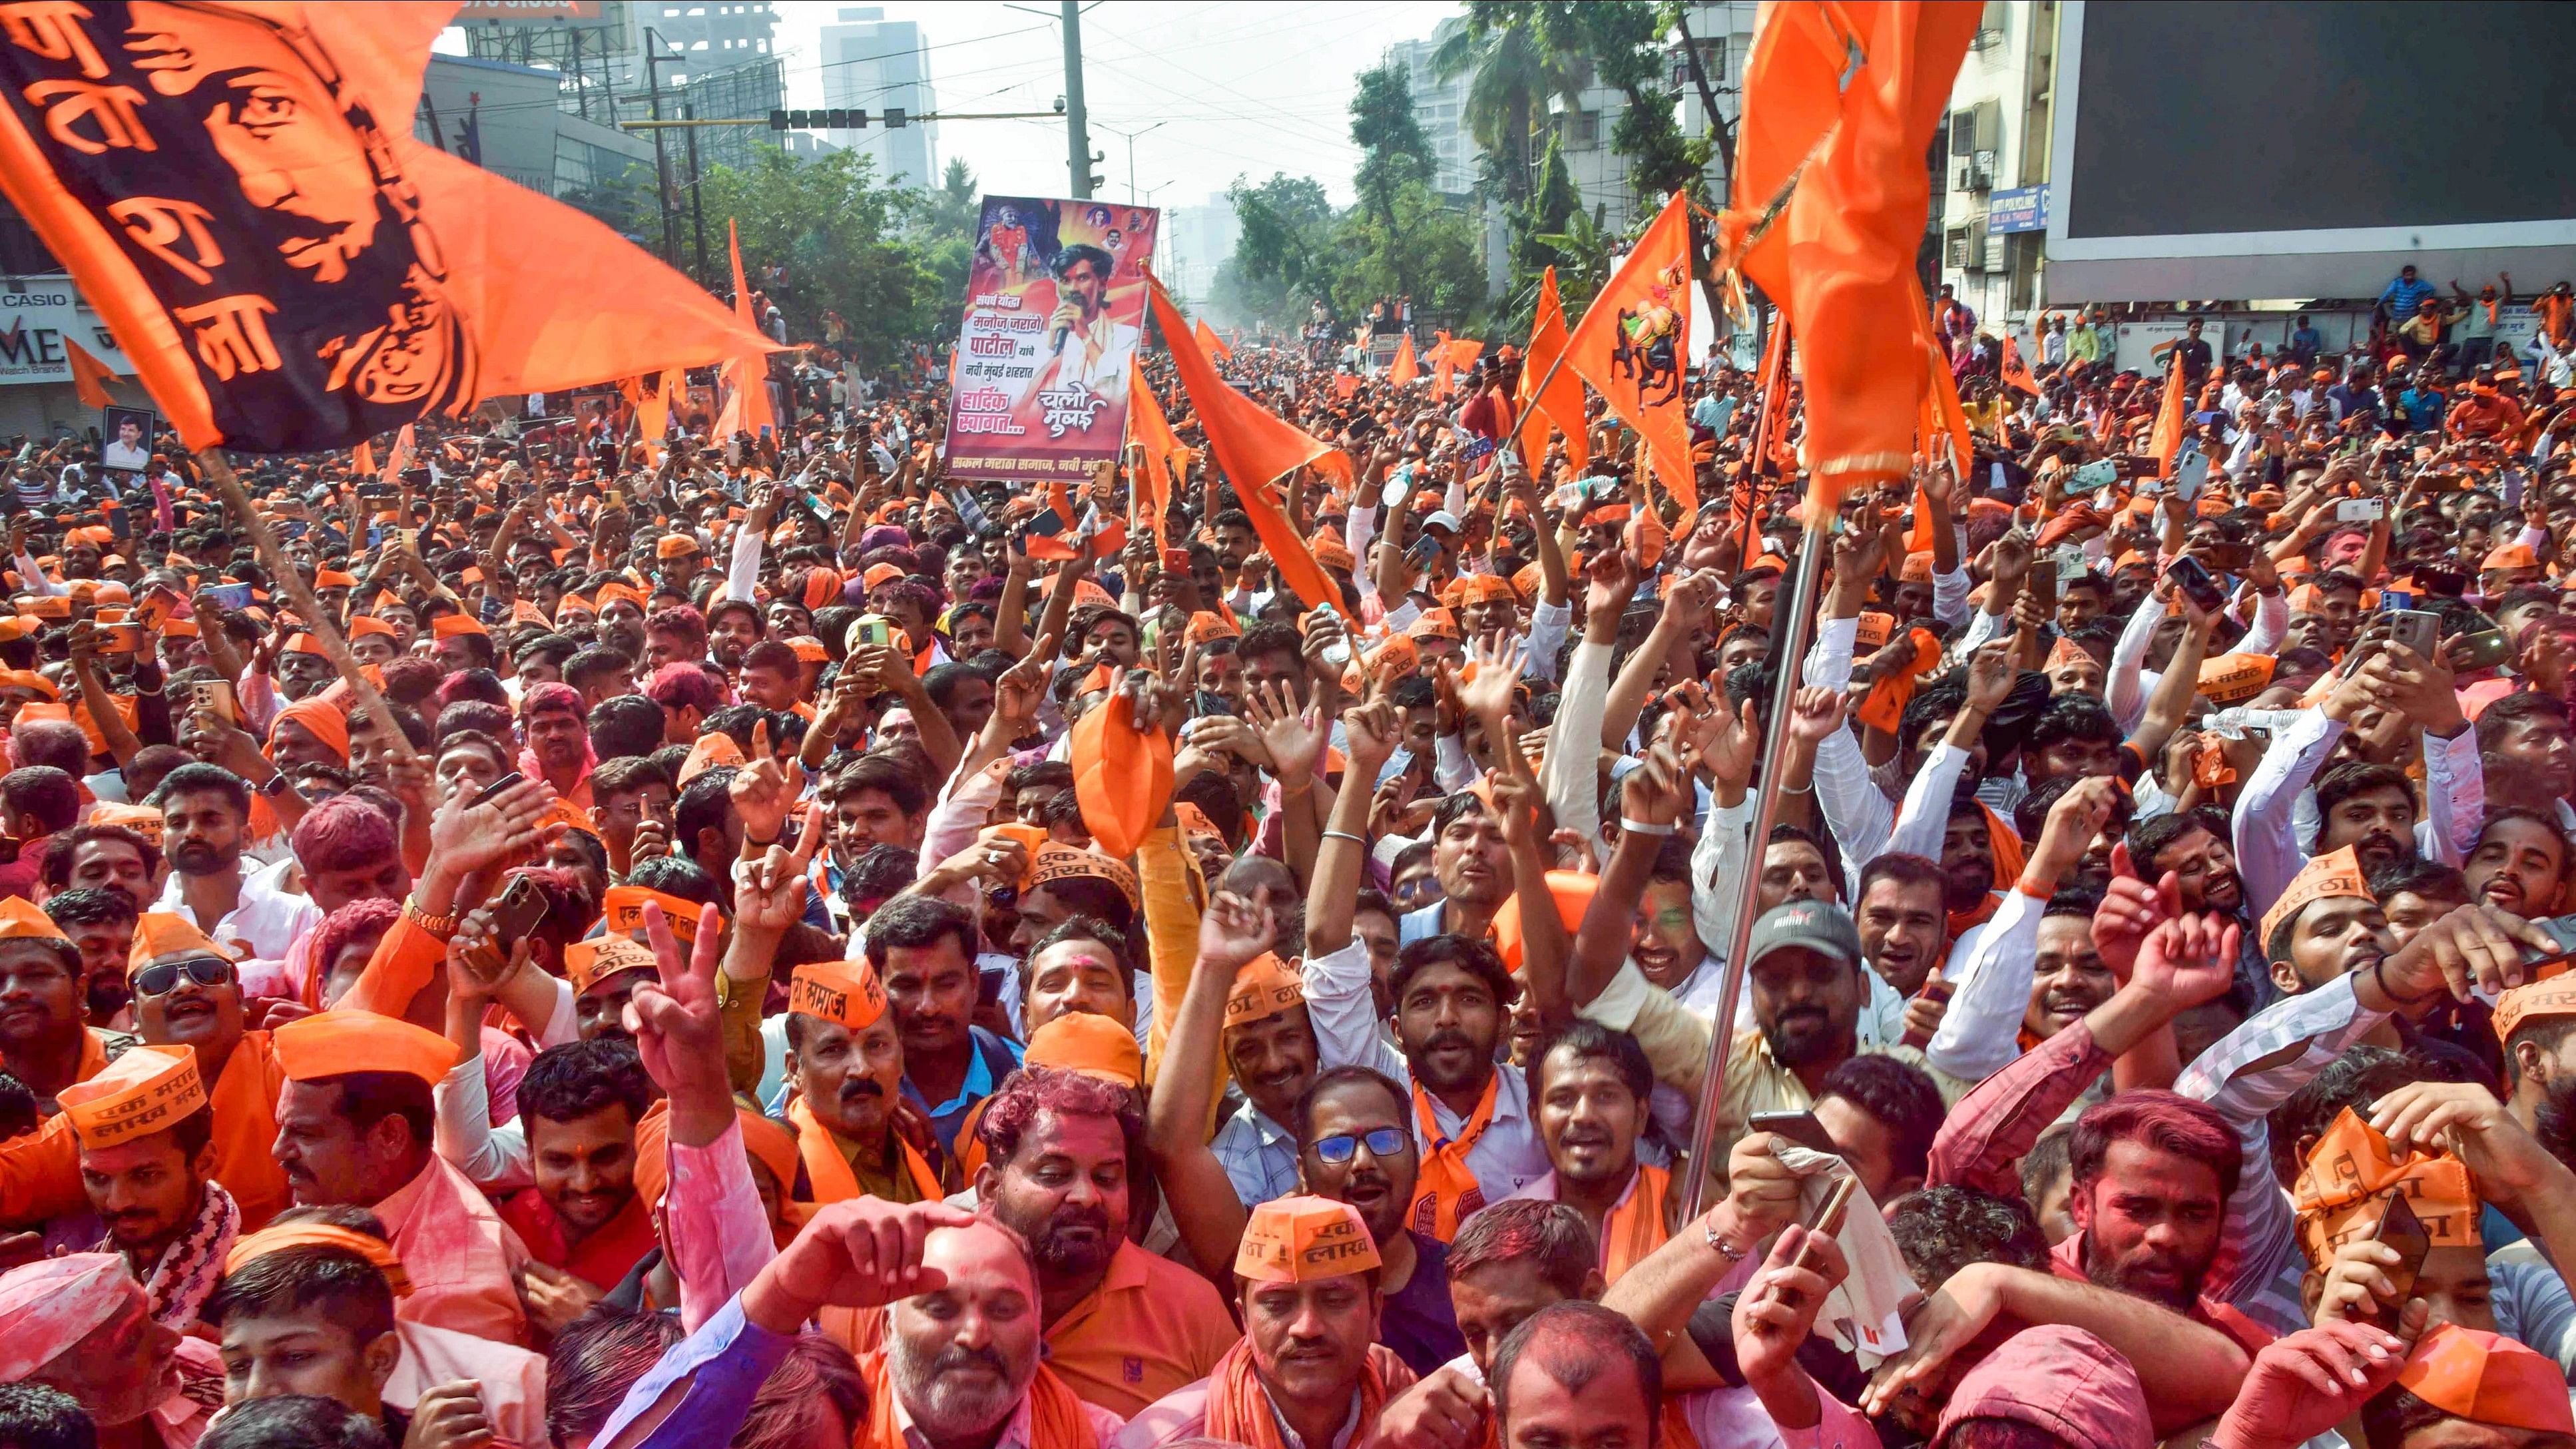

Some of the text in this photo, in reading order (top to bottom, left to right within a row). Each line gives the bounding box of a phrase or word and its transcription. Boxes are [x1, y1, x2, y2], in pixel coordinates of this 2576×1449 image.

[3, 294, 67, 306] CASIO
[973, 314, 1043, 331] मनोज जरांगे
[970, 333, 1035, 356] पाटील यांचे
[0, 366, 66, 376] Watch Brands
[965, 362, 1034, 382] नवी मुंबई शहरात
[960, 386, 1009, 410] हार्दिक
[1038, 382, 1092, 408] चलो
[1043, 400, 1107, 437] मुंबई
[952, 457, 983, 469] सकल
[985, 457, 1017, 470] मराठा
[1017, 459, 1055, 472] समाज,
[1059, 457, 1081, 471] नवी
[1037, 851, 1079, 866] एक
[1031, 864, 1091, 886] लाख
[618, 905, 642, 926] एक
[91, 1094, 146, 1120] एक
[91, 1101, 168, 1137] लाख
[1309, 1219, 1356, 1239] एक
[1304, 1238, 1369, 1264] लाख
